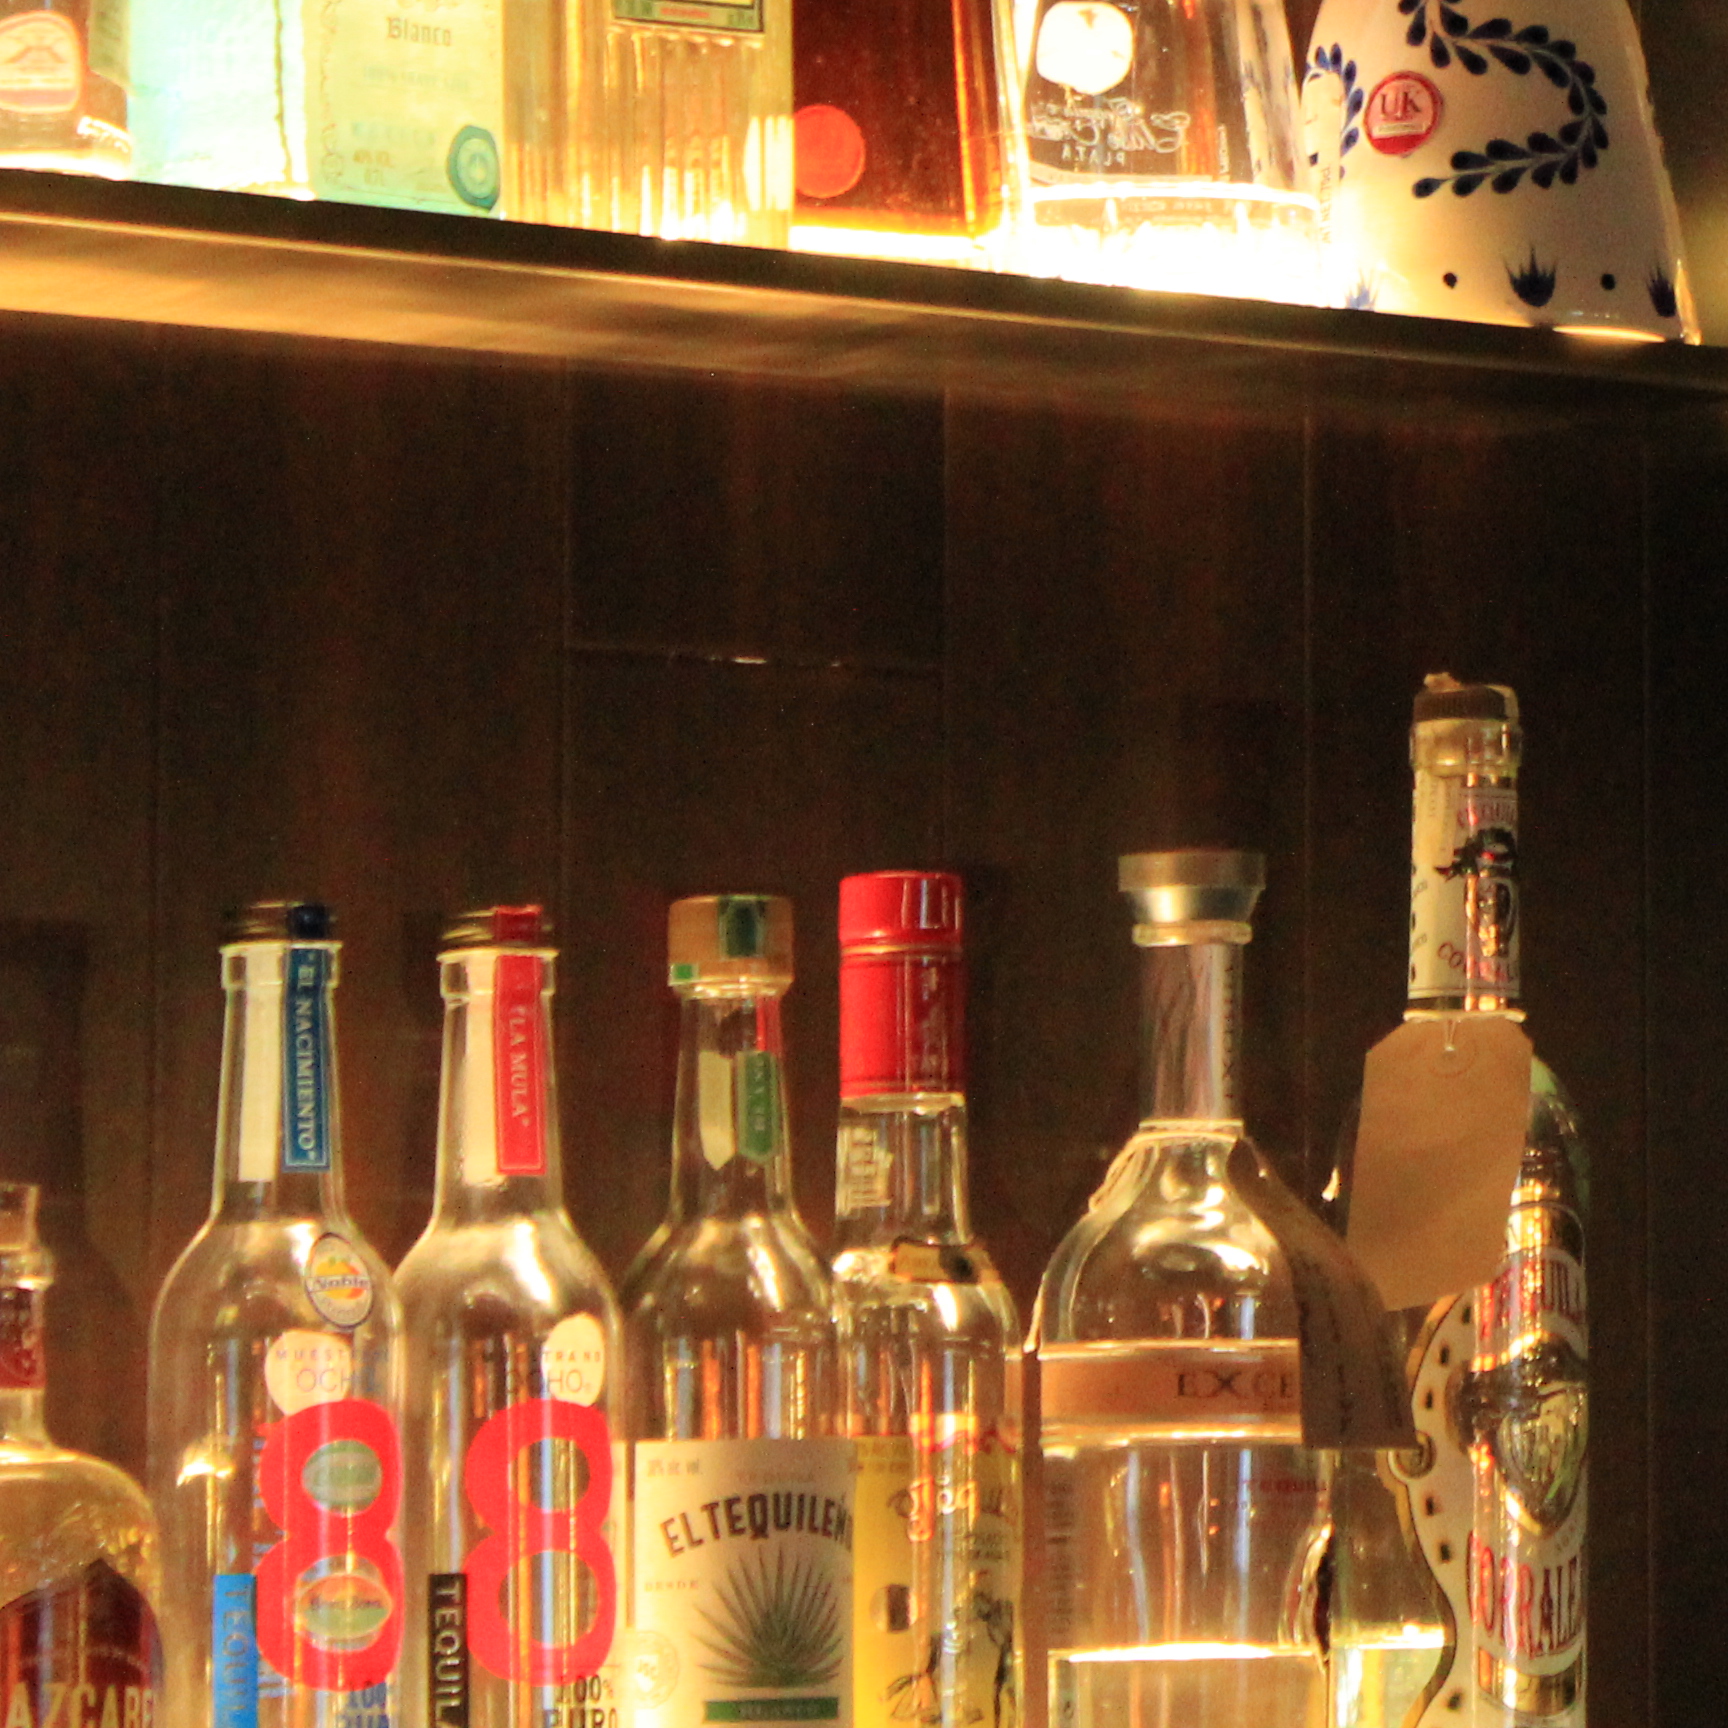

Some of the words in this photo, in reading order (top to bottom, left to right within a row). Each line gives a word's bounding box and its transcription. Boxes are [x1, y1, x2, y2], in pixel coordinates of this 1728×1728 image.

[386, 16, 452, 47] Blanco
[1378, 88, 1422, 122] UK
[253, 1398, 404, 1692] 8
[462, 1398, 617, 1687] 8
[660, 1512, 704, 1559] EL
[644, 1579, 700, 1592] DESDE
